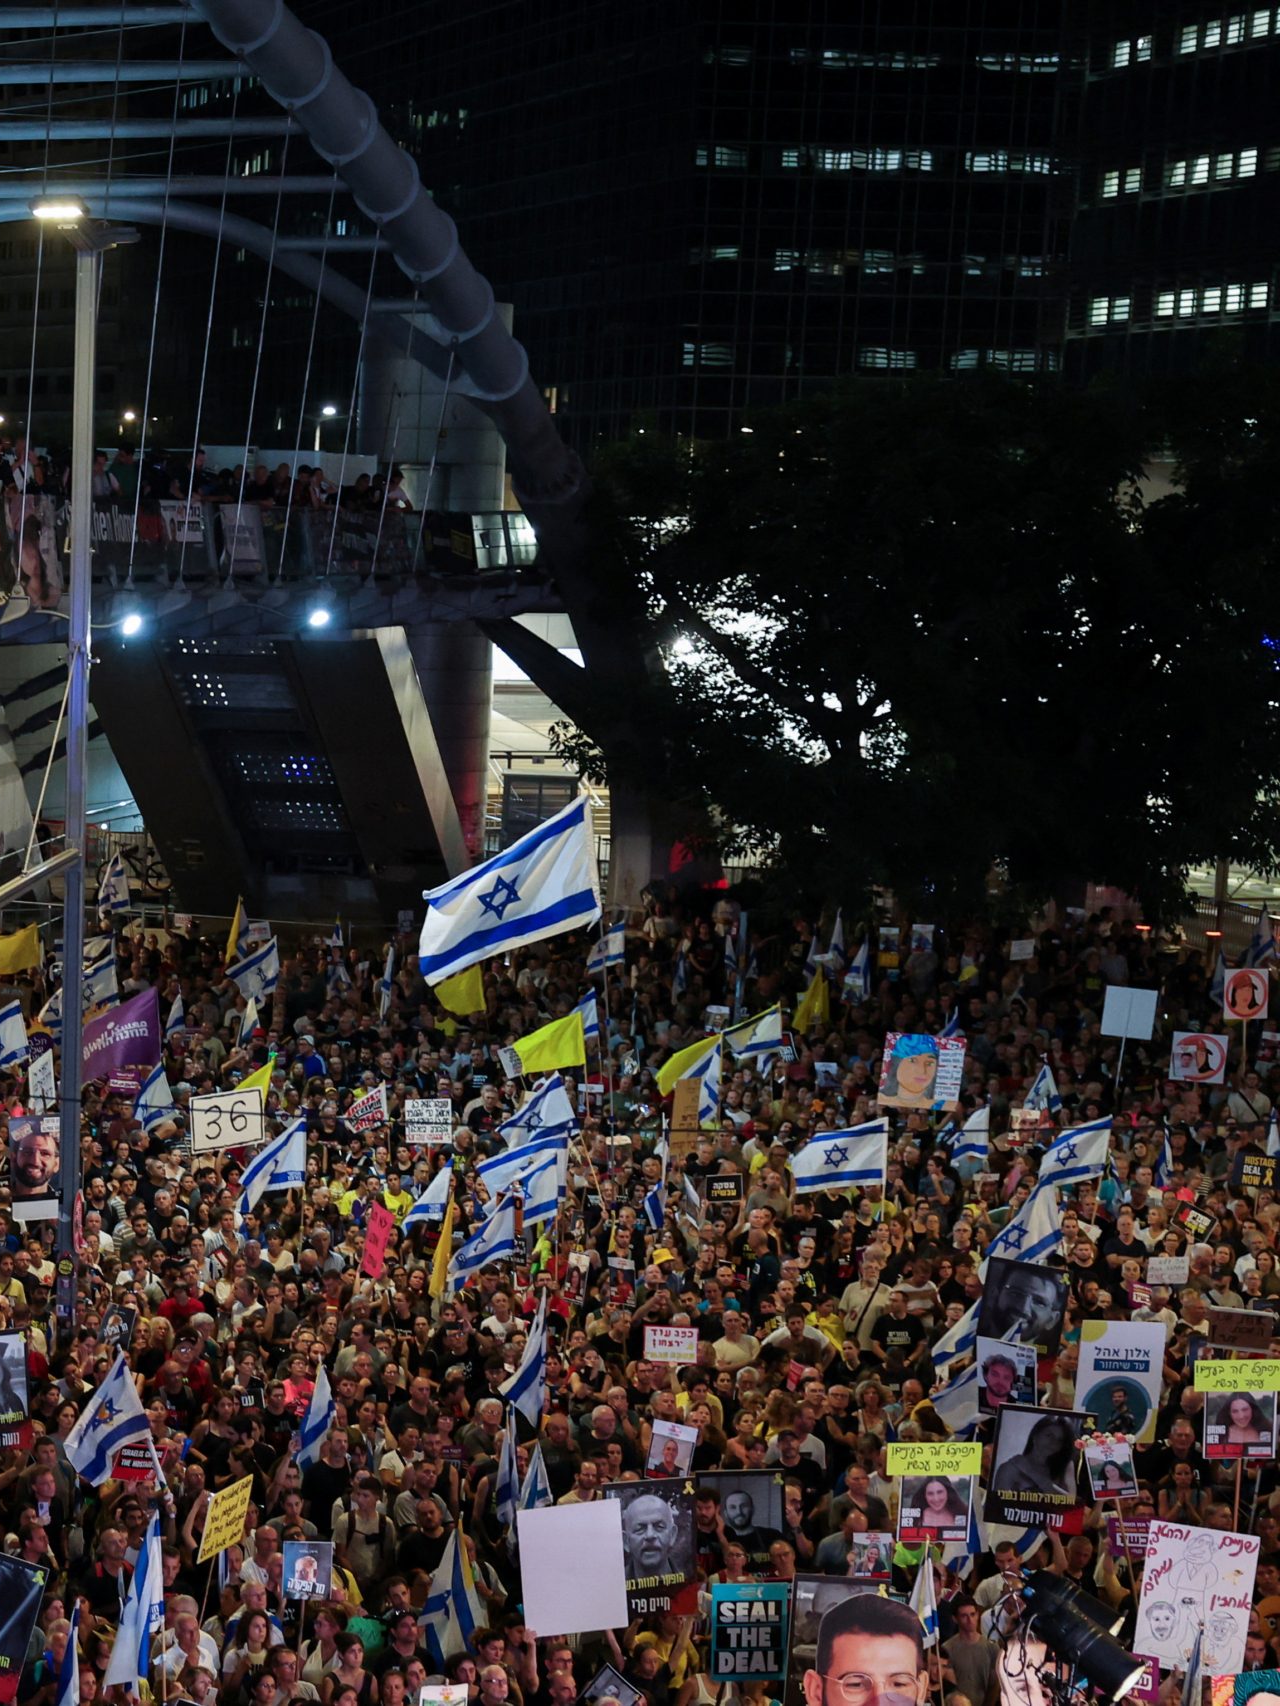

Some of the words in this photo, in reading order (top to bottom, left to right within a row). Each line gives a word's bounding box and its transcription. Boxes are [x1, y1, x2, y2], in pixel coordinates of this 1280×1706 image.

[205, 1100, 248, 1140] 36
[1244, 1155, 1277, 1168] HOSTAGE
[1242, 1164, 1262, 1176] DEAL
[713, 1181, 735, 1190] עסקה
[1241, 1174, 1261, 1186] NOW
[651, 1328, 671, 1338] עוד
[1094, 1346, 1120, 1357] אהל
[1124, 1347, 1151, 1360] אלון
[1099, 1360, 1131, 1370] שיחזור
[1133, 1361, 1146, 1370] עד
[1230, 1363, 1249, 1375] לה
[1245, 1378, 1265, 1389] עסקה
[1206, 1424, 1226, 1435] BRING
[2, 1431, 20, 1446] נועה
[1206, 1434, 1220, 1444] HER
[930, 1443, 945, 1456] לה
[946, 1443, 976, 1458] תסתכל
[121, 1458, 131, 1467] THE
[935, 1460, 962, 1473] עסקה
[997, 1489, 1018, 1501] בשבי
[1020, 1490, 1044, 1503] למוות
[901, 1508, 921, 1518] BRING
[1004, 1507, 1044, 1525] ירושלמי
[901, 1518, 914, 1528] HER
[1046, 1512, 1064, 1528] עדן
[287, 1578, 313, 1593] הפקרה
[625, 1579, 636, 1591] בש
[638, 1575, 660, 1590] למוות
[661, 1571, 685, 1587] הופקר
[315, 1583, 326, 1595] מר
[631, 1598, 648, 1614] פרי
[649, 1596, 671, 1612] חיים
[719, 1601, 780, 1624] SEAL
[726, 1626, 772, 1648] THE
[718, 1650, 779, 1674] DEAL
